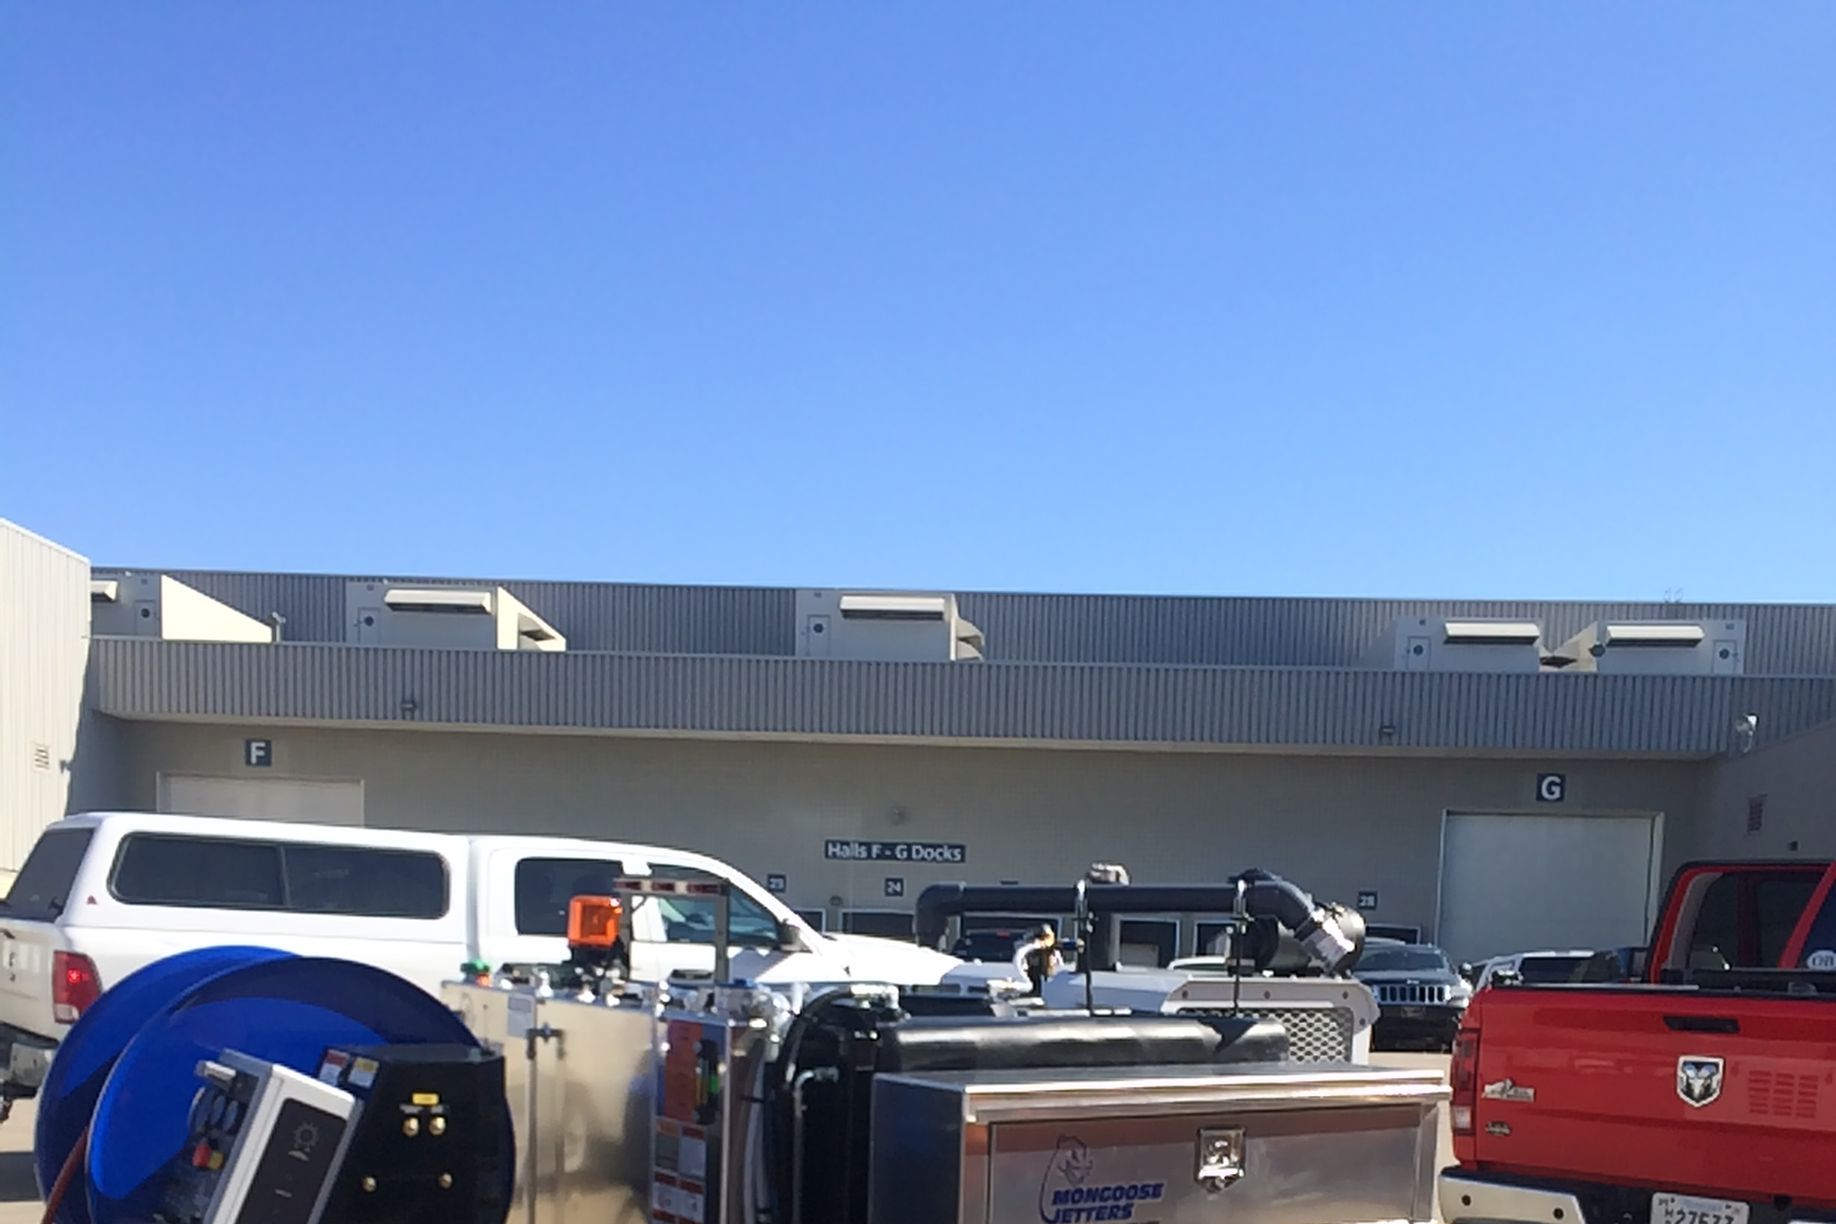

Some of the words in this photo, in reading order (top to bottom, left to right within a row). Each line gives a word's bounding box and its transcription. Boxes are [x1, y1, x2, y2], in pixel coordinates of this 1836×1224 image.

[250, 741, 266, 765] F
[1541, 775, 1562, 800] G
[827, 842, 868, 859] Halls
[870, 844, 882, 859] F
[894, 844, 908, 860] G
[911, 844, 962, 861] Docks
[1051, 1183, 1165, 1206] MONGOOSE
